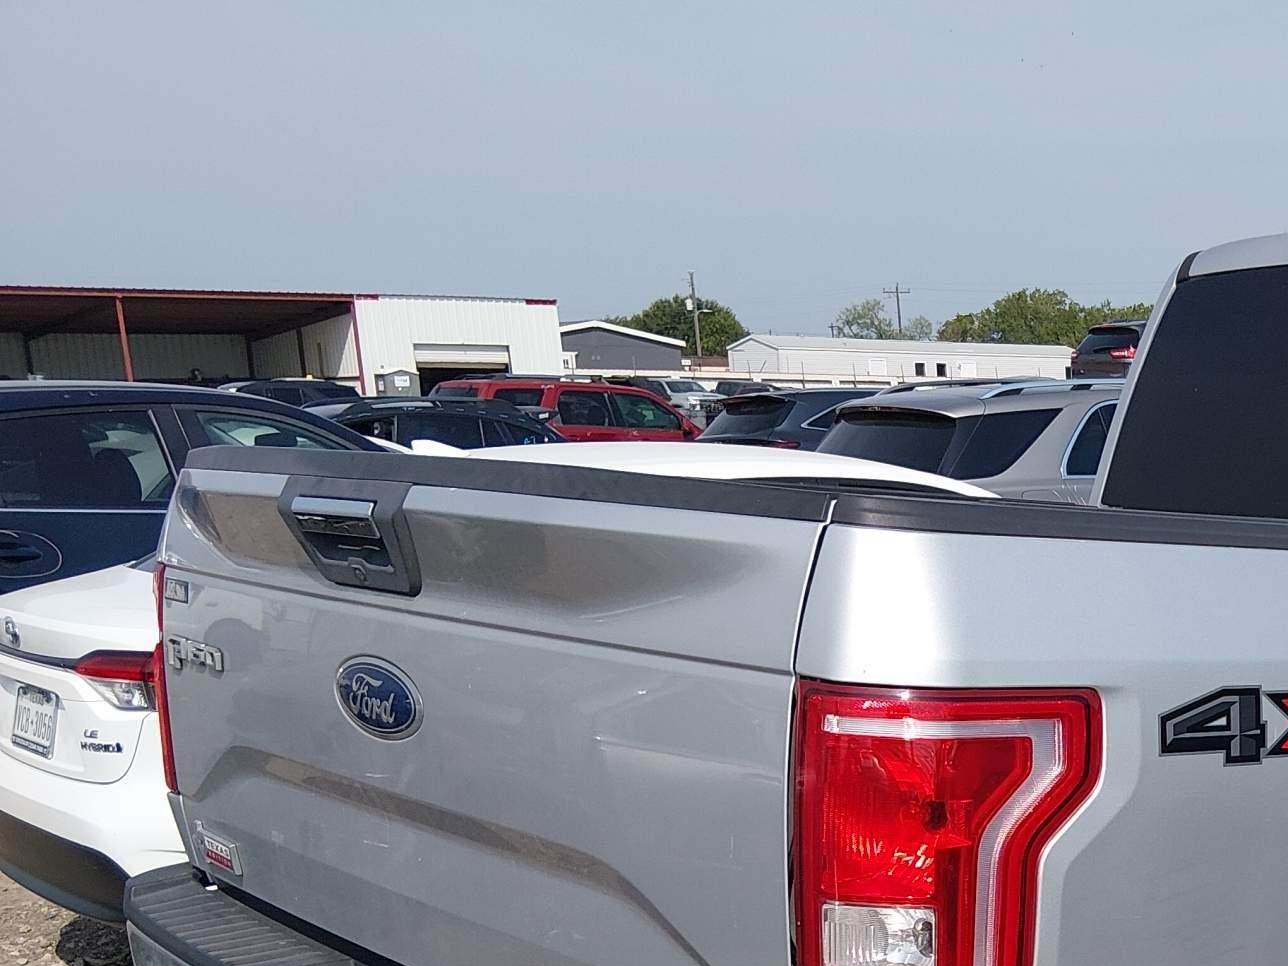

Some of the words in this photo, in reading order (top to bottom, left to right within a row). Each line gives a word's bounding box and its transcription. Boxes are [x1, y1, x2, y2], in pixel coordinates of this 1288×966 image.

[349, 672, 396, 724] Ford
[83, 728, 99, 740] LE
[80, 740, 116, 754] HYBRID
